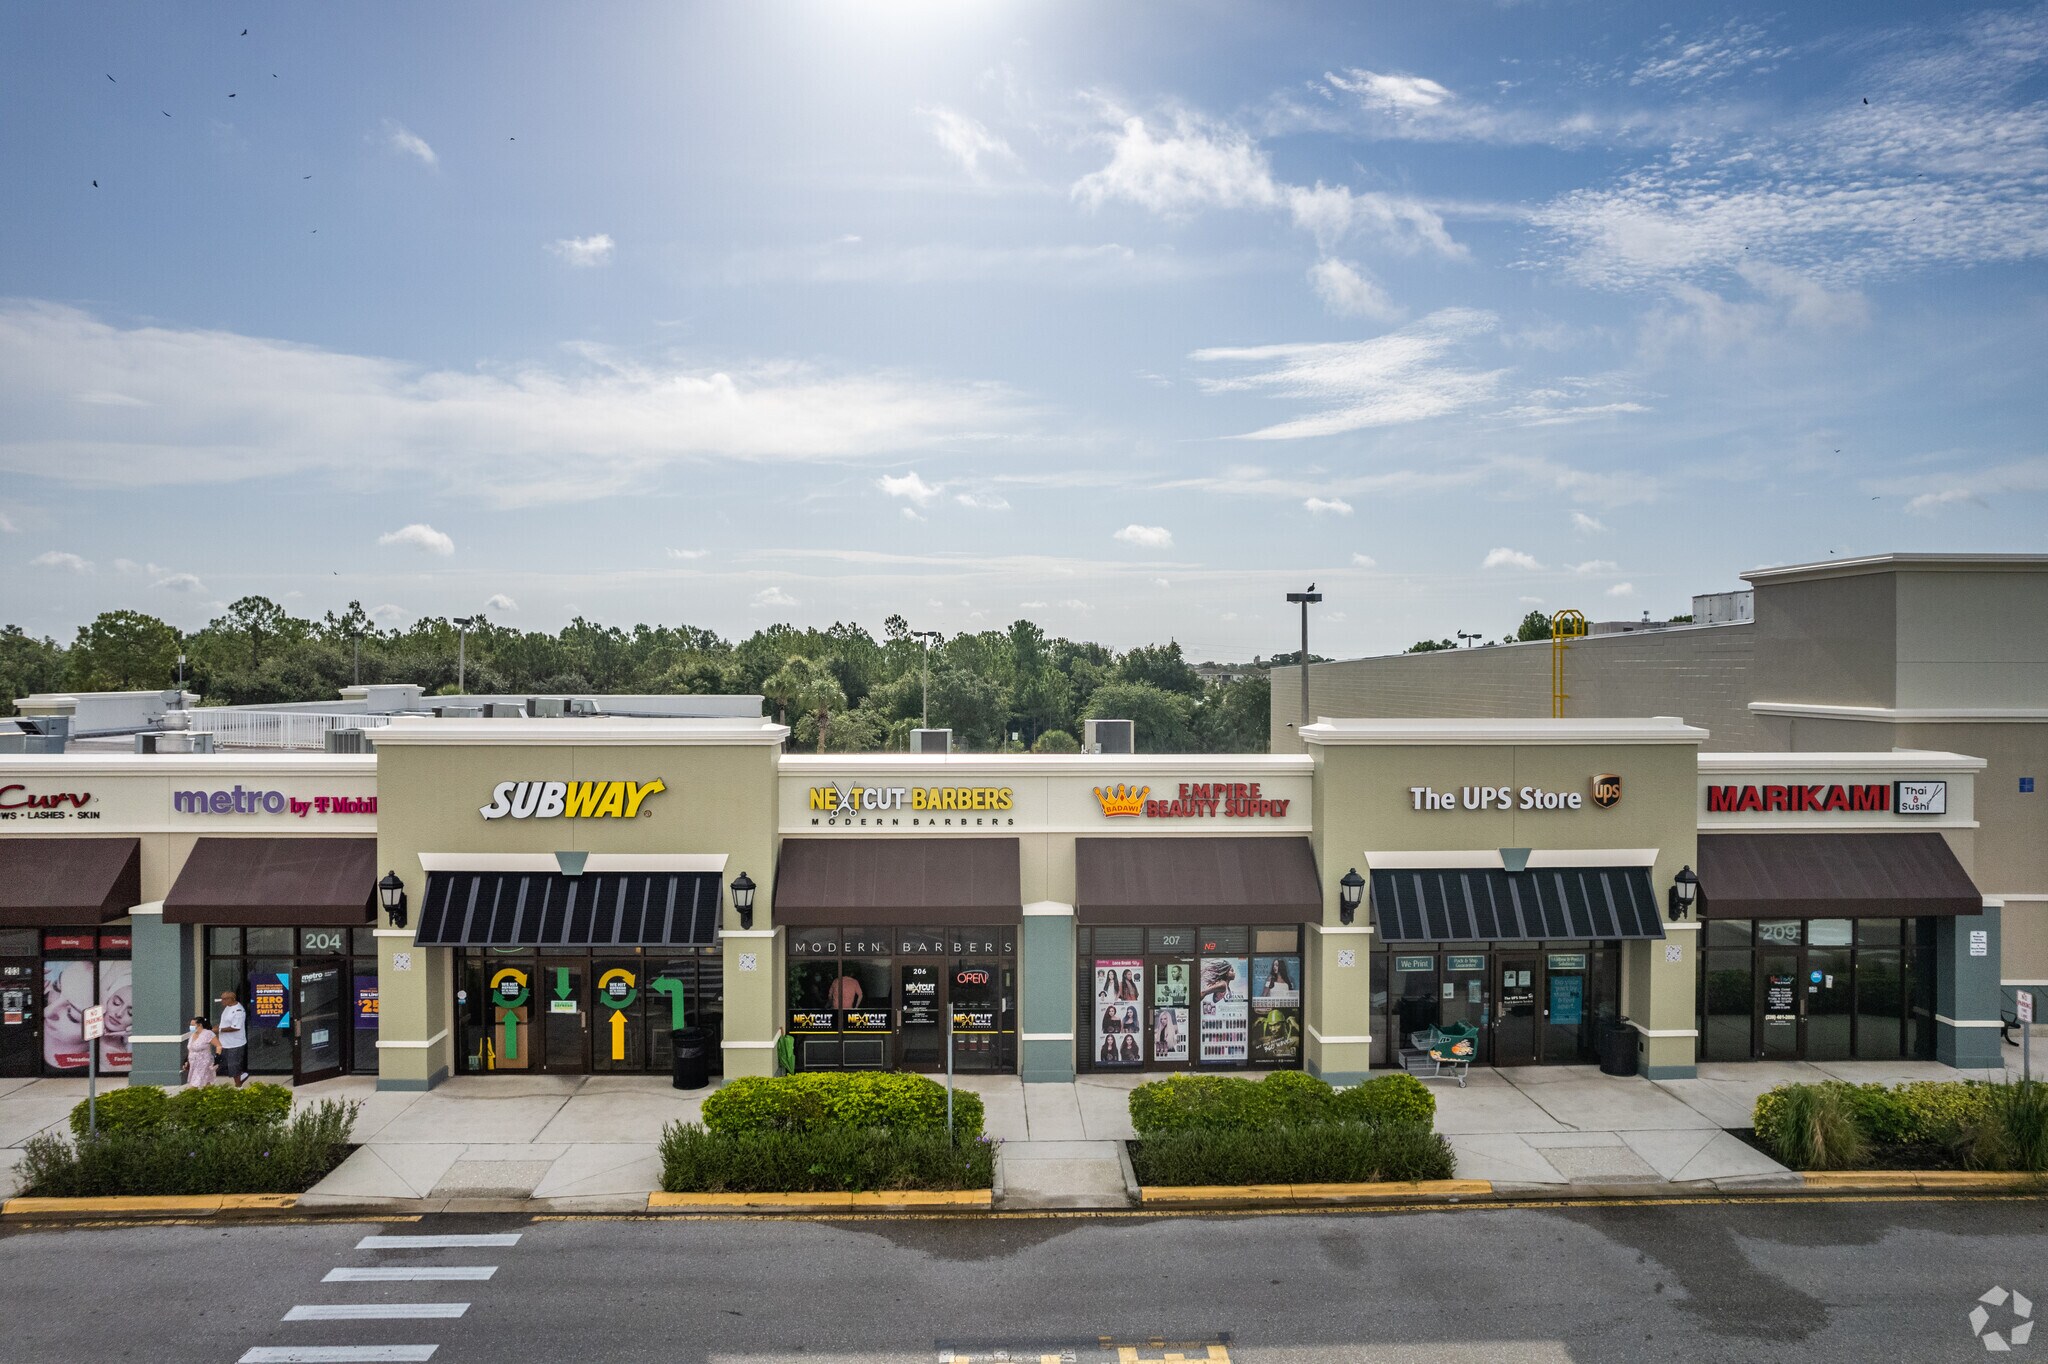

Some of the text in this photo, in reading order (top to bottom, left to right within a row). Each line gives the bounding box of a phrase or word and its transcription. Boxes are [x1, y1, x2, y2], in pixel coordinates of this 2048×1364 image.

[1178, 783, 1263, 800] EMPIRE
[1594, 783, 1620, 804] ups
[1904, 786, 1927, 796] Thai
[174, 785, 285, 814] metro
[289, 796, 312, 818] by
[331, 796, 377, 814] Mobil
[478, 777, 666, 820] SUBWAY
[809, 783, 1014, 816] NEXTCUT BARBERS
[1410, 786, 1582, 810] The UPS Store
[1707, 784, 1890, 812] MARIKAMI
[1912, 795, 1919, 804] &
[1106, 804, 1139, 813] BADAWI
[1146, 799, 1291, 818] BEAUTY SUPPLY
[1902, 802, 1929, 811] Sushi
[0, 811, 100, 819] WS LASHES SKIN
[811, 818, 1014, 826] MODERN BARBERS
[1762, 925, 1797, 940] 209
[305, 933, 342, 949] 204
[1163, 935, 1180, 945] 207
[795, 942, 1012, 952] MODERN BARBERS
[1400, 960, 1428, 968] We Print
[301, 972, 323, 981] metro
[957, 972, 987, 984] OPEN
[905, 982, 936, 993] NEXTCUT
[793, 1013, 833, 1025] NEXTCUT
[847, 1013, 888, 1025] NEXTCUT
[953, 1013, 993, 1025] NEXTCUT
